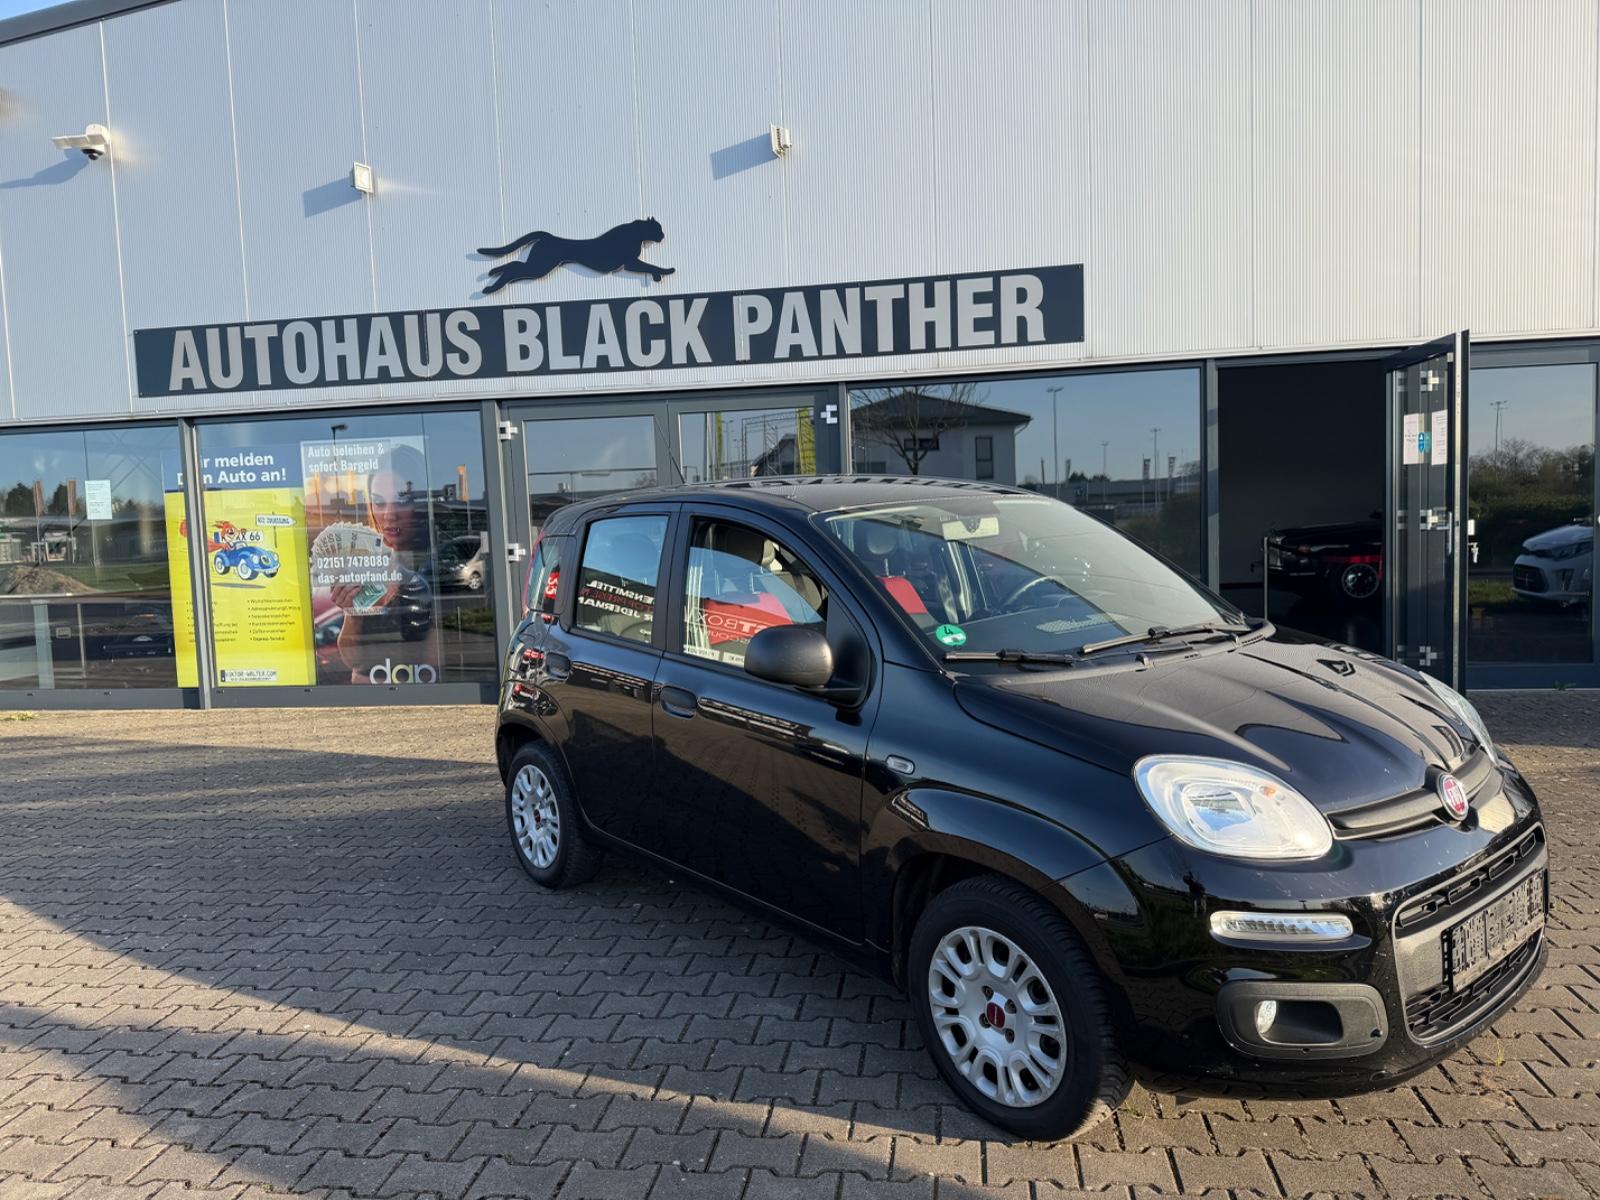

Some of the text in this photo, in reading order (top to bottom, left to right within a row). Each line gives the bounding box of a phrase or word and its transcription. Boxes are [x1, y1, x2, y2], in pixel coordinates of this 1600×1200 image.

[169, 274, 1046, 391] AUTOHAUS BLACK PANTHER
[308, 442, 384, 457] Auto beleihen &
[215, 453, 274, 467] melden
[308, 459, 379, 472] sofort Bargeld
[218, 470, 256, 483] Auto
[261, 468, 287, 481] an!
[317, 555, 389, 568] 02151 7478080
[318, 570, 402, 584] das-autopfand.de
[944, 626, 954, 635] 4
